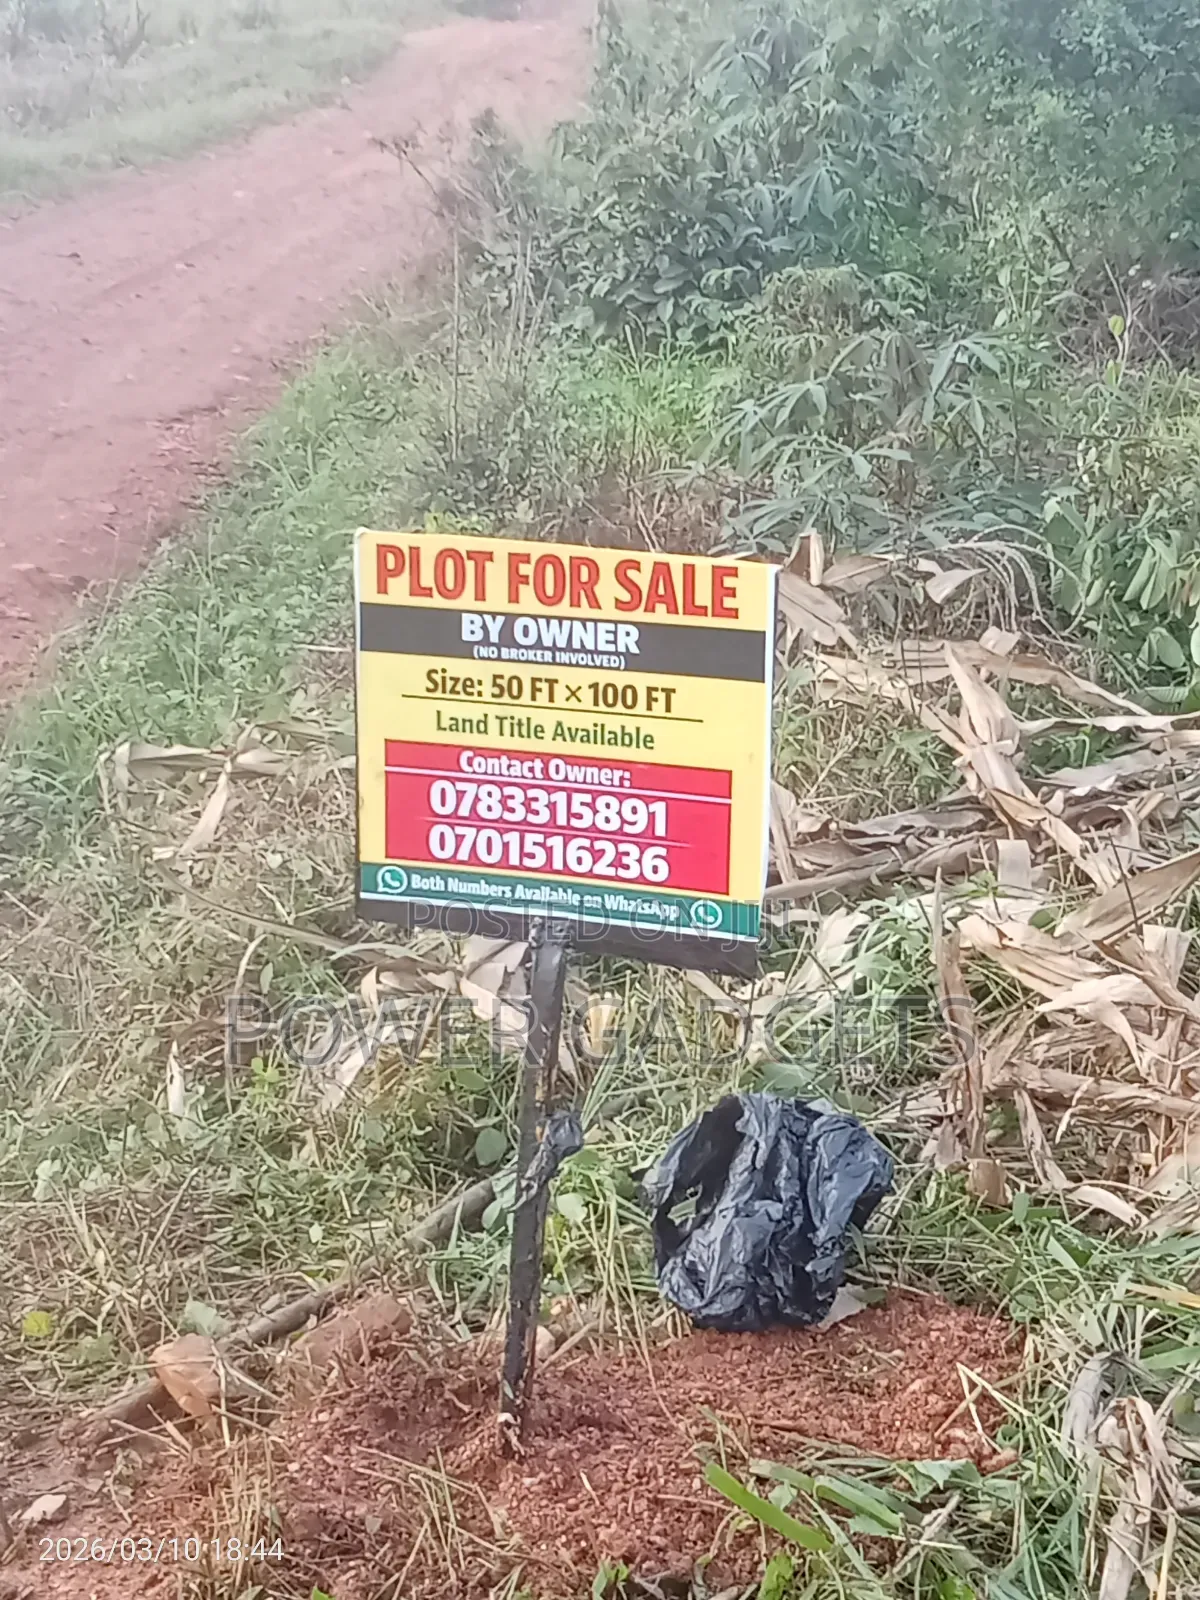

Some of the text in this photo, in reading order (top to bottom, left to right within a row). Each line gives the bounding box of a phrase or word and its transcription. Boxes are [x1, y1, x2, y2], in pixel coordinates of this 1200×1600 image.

[376, 544, 739, 619] PLOT FOR SALE
[461, 613, 640, 654] BY OWNER
[473, 645, 625, 670] (NO BROKER INVOLVED)
[426, 669, 483, 697] Size:
[491, 675, 522, 700] 50
[530, 678, 559, 703] FT
[589, 681, 638, 709] 100
[646, 687, 676, 713] FT
[436, 711, 655, 750] Land Title Available
[459, 750, 630, 787] Contact Owner:
[429, 780, 668, 837] 0783315891
[428, 825, 669, 882] 0701516236
[411, 873, 680, 921] Both Numbers Available on WhatsApp
